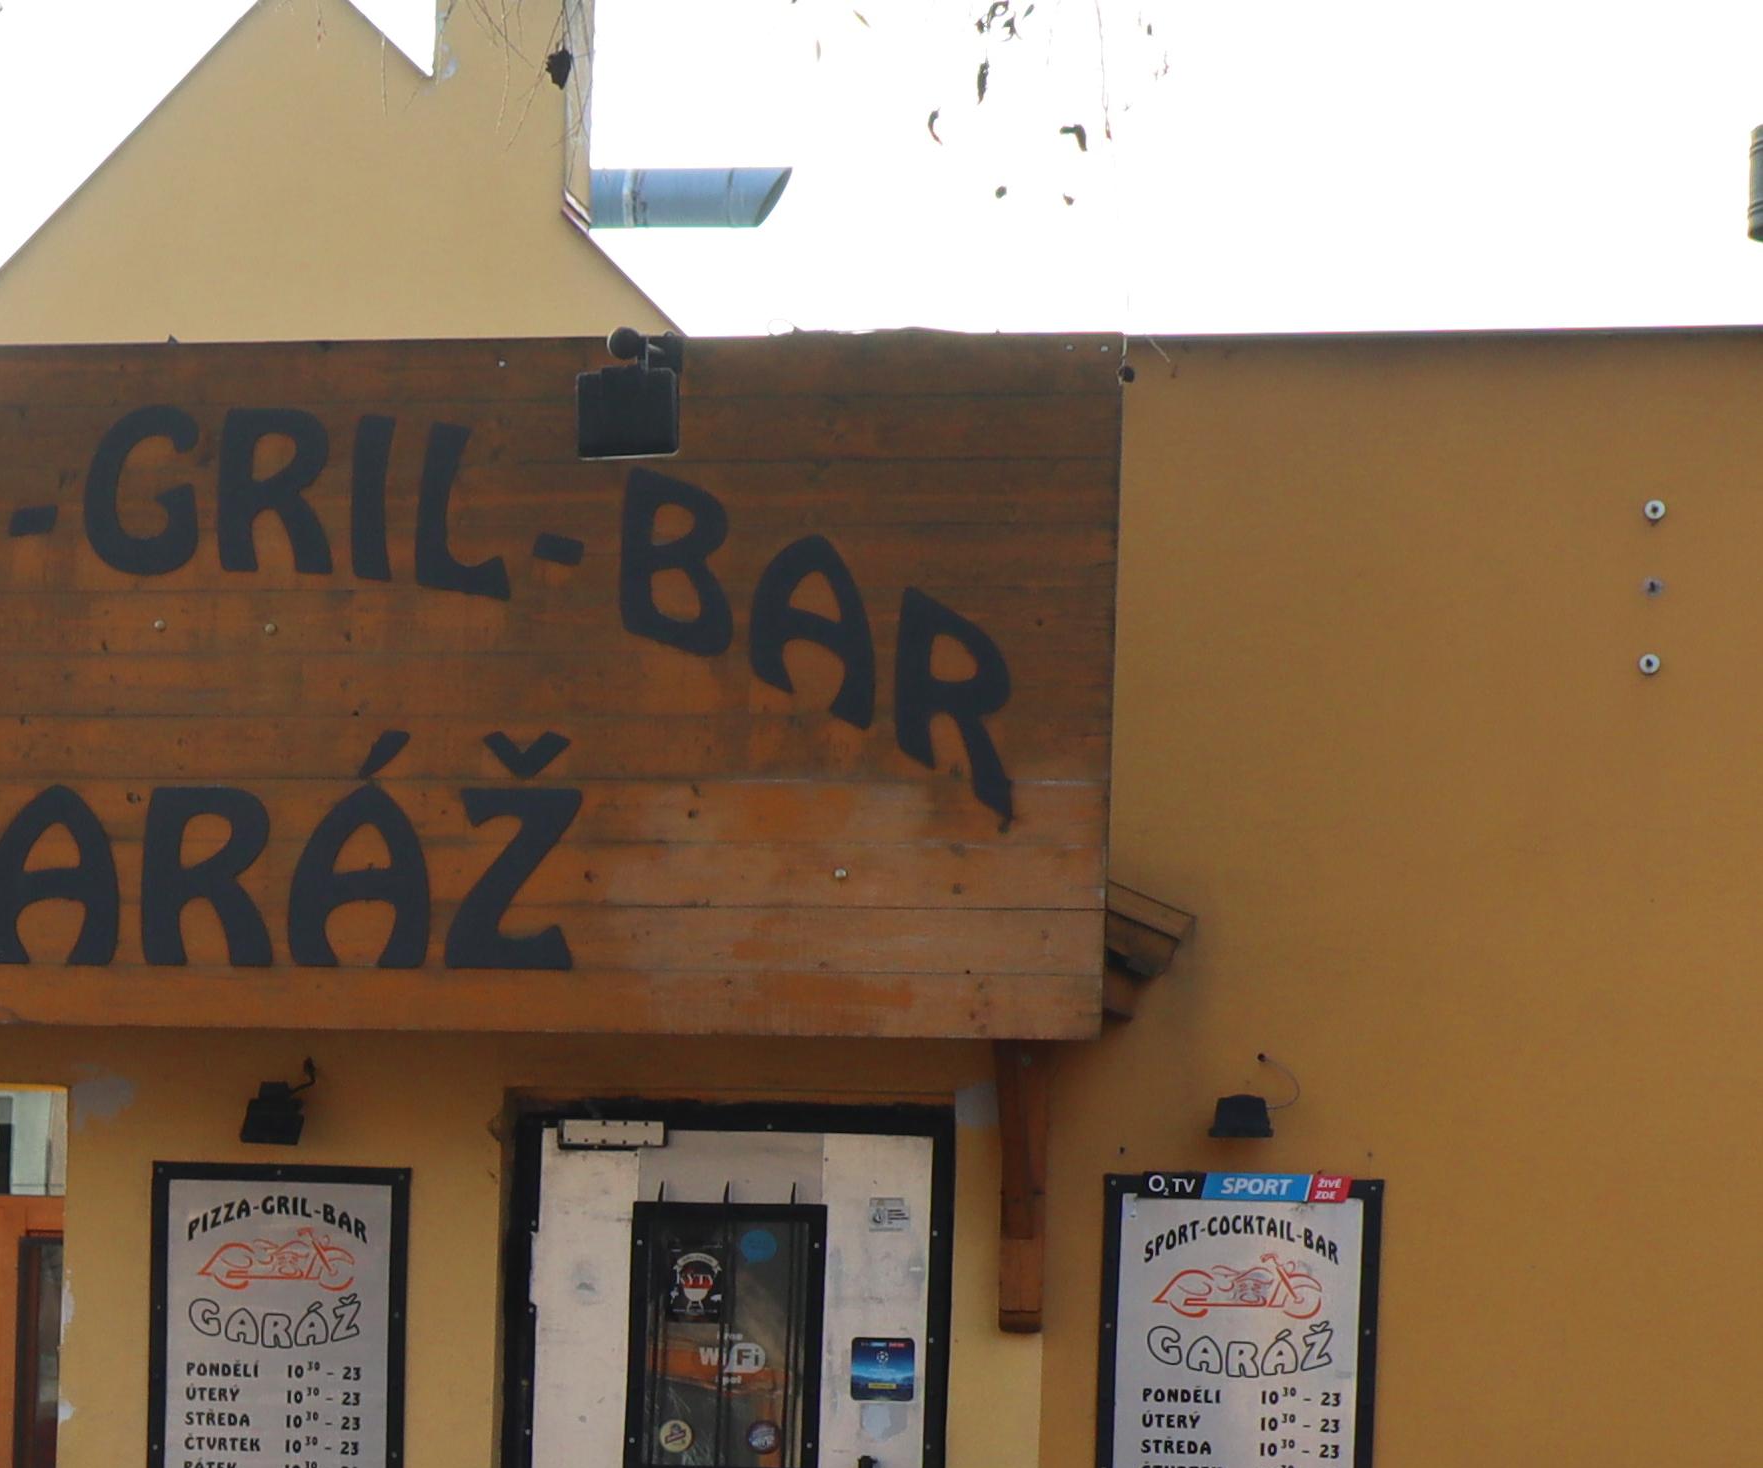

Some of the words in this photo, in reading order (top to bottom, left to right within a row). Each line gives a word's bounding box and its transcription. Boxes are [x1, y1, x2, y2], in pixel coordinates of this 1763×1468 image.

[1171, 1178, 1196, 1193] TV
[1220, 1178, 1293, 1196] SPORT
[188, 1292, 362, 1350] GARÁŽ
[1146, 1319, 1334, 1379] GARÁŽ
[342, 1365, 362, 1382] 23
[341, 1391, 361, 1407] 23
[1320, 1391, 1341, 1408] 23
[340, 1415, 361, 1431] 23
[1319, 1418, 1341, 1434] 23
[340, 1440, 360, 1456] 23
[1318, 1443, 1340, 1460] 23
